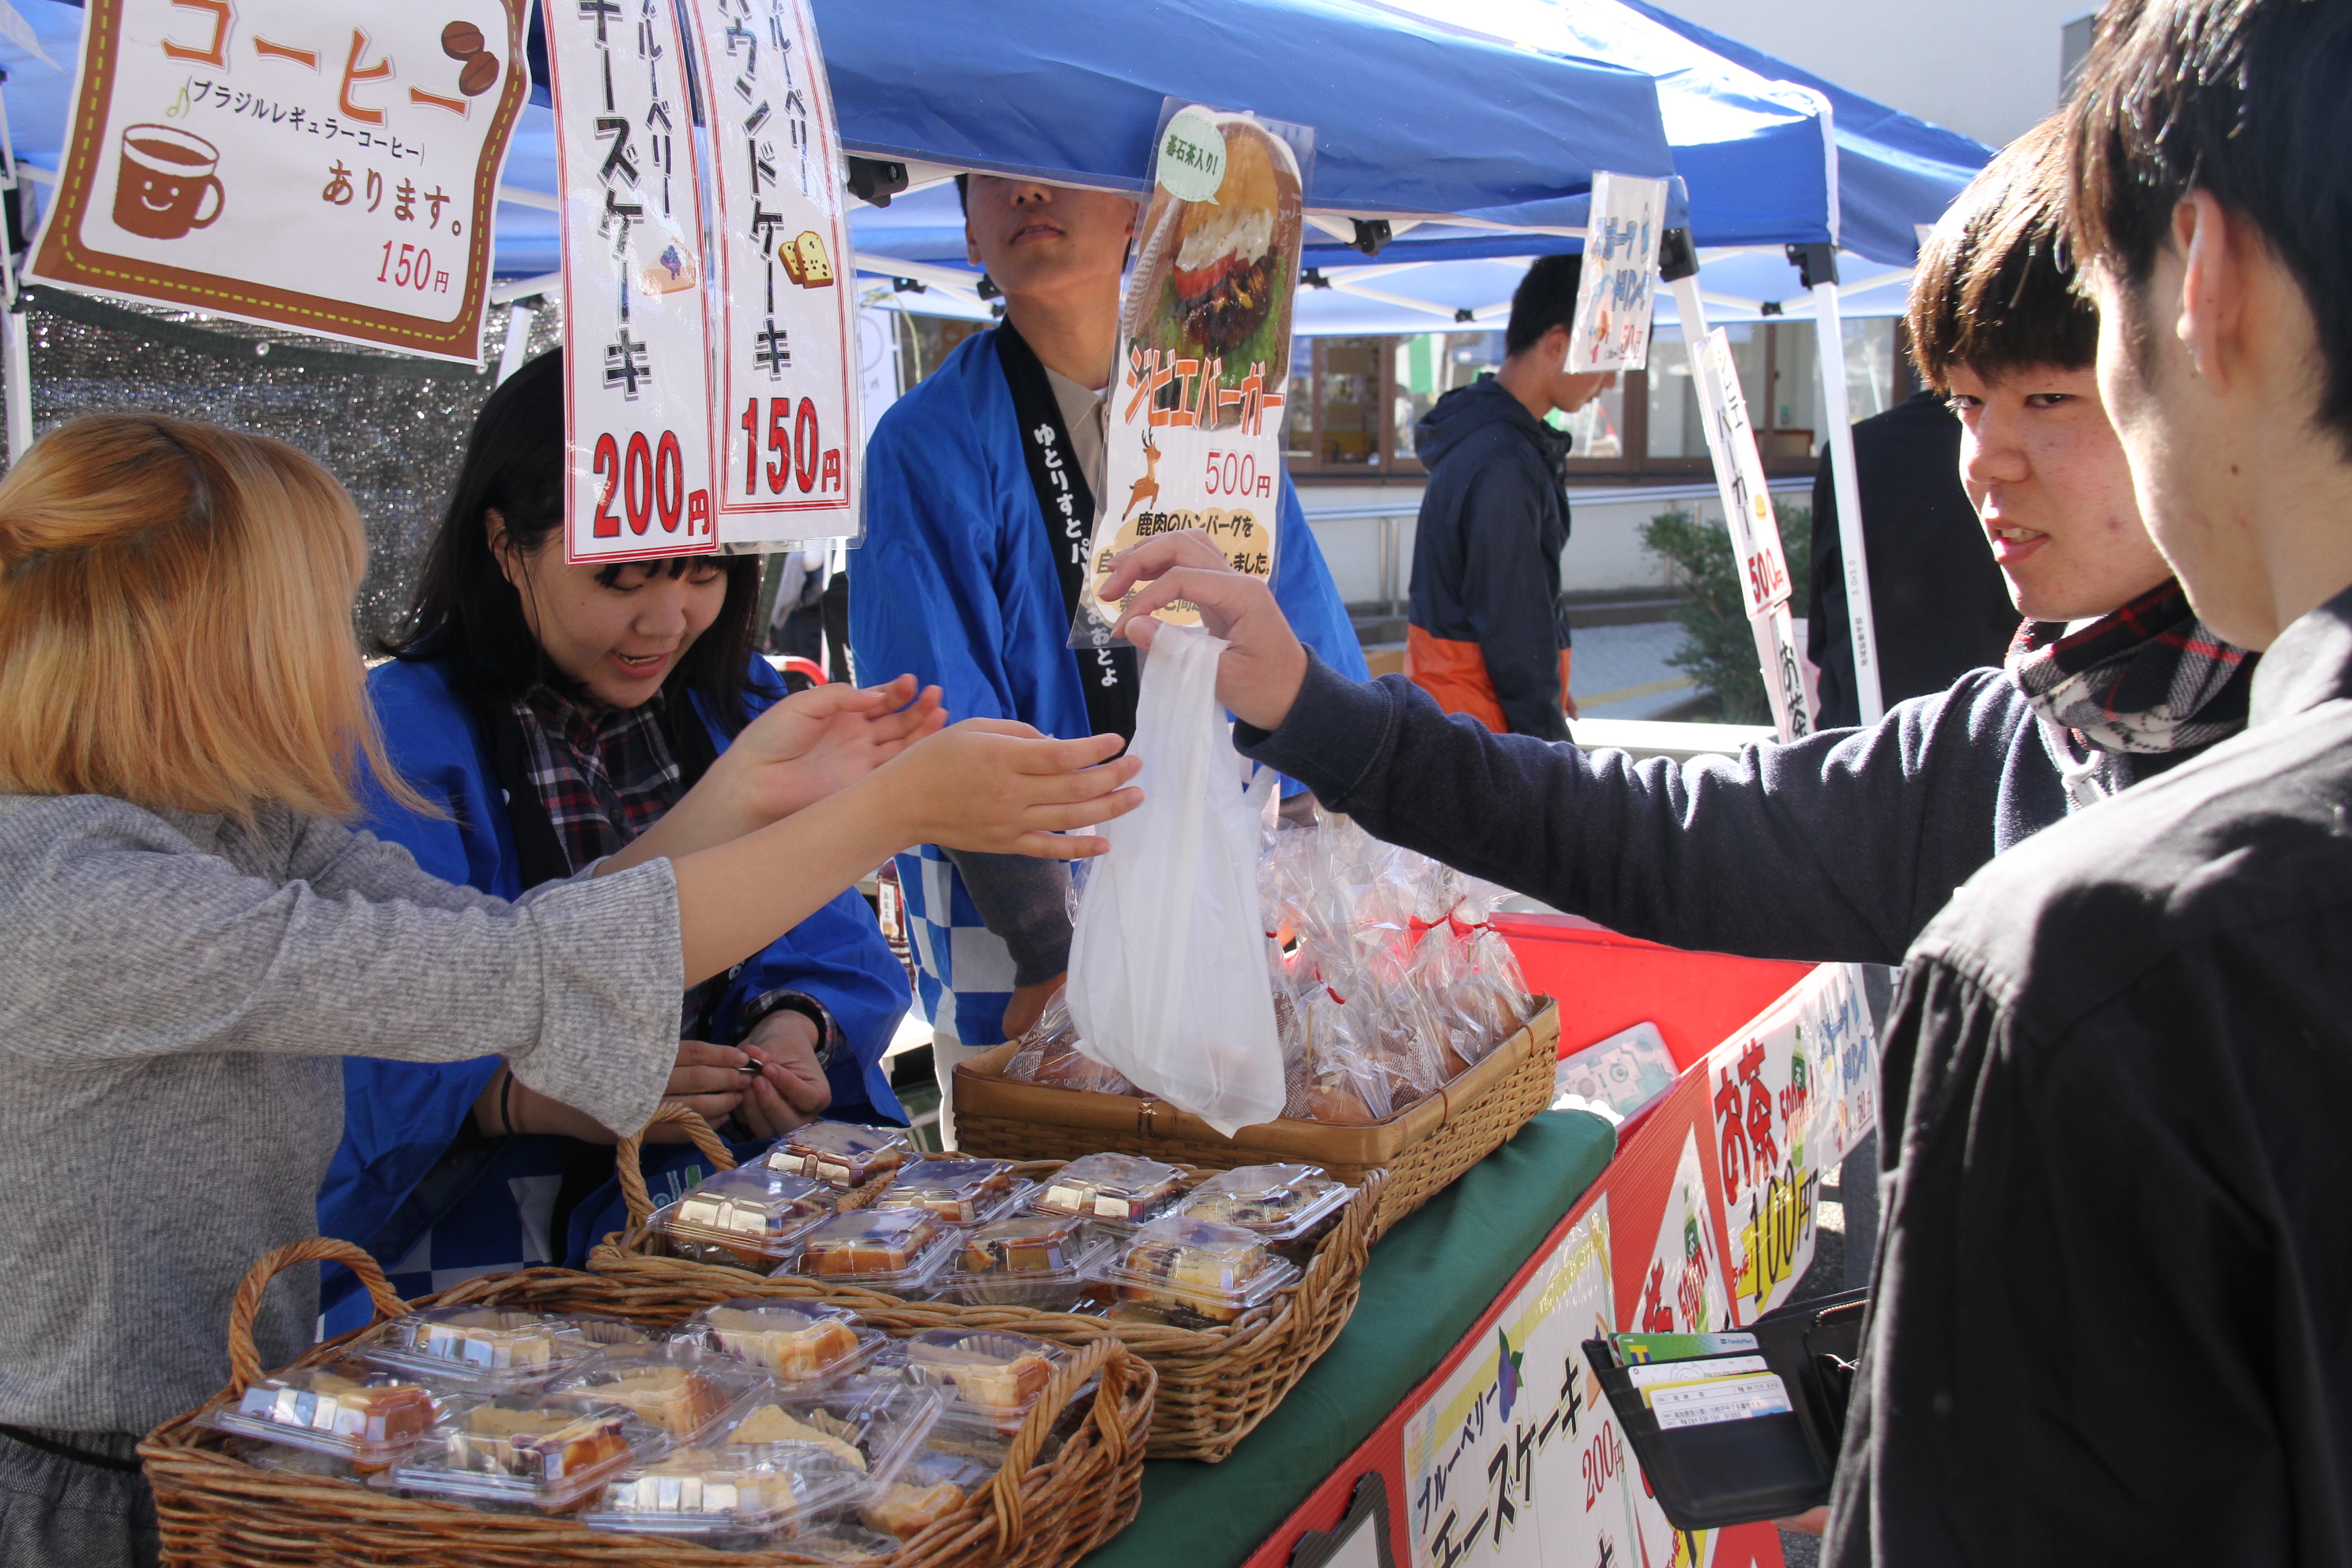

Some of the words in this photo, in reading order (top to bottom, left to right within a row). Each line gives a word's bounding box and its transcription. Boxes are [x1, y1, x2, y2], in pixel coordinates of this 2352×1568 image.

[161, 0, 470, 126] コーヒー
[322, 159, 462, 238] あります。
[377, 240, 450, 294] 150円
[1125, 344, 1286, 437] ジビエバーガー
[593, 429, 710, 538] 200円
[742, 397, 841, 495] 150円
[1205, 451, 1271, 498] 500円
[1748, 547, 1784, 604] 500円
[1714, 1038, 1778, 1207] お茶
[1417, 1380, 1498, 1535] ブルーベリー
[1582, 1420, 1624, 1515] 200円
